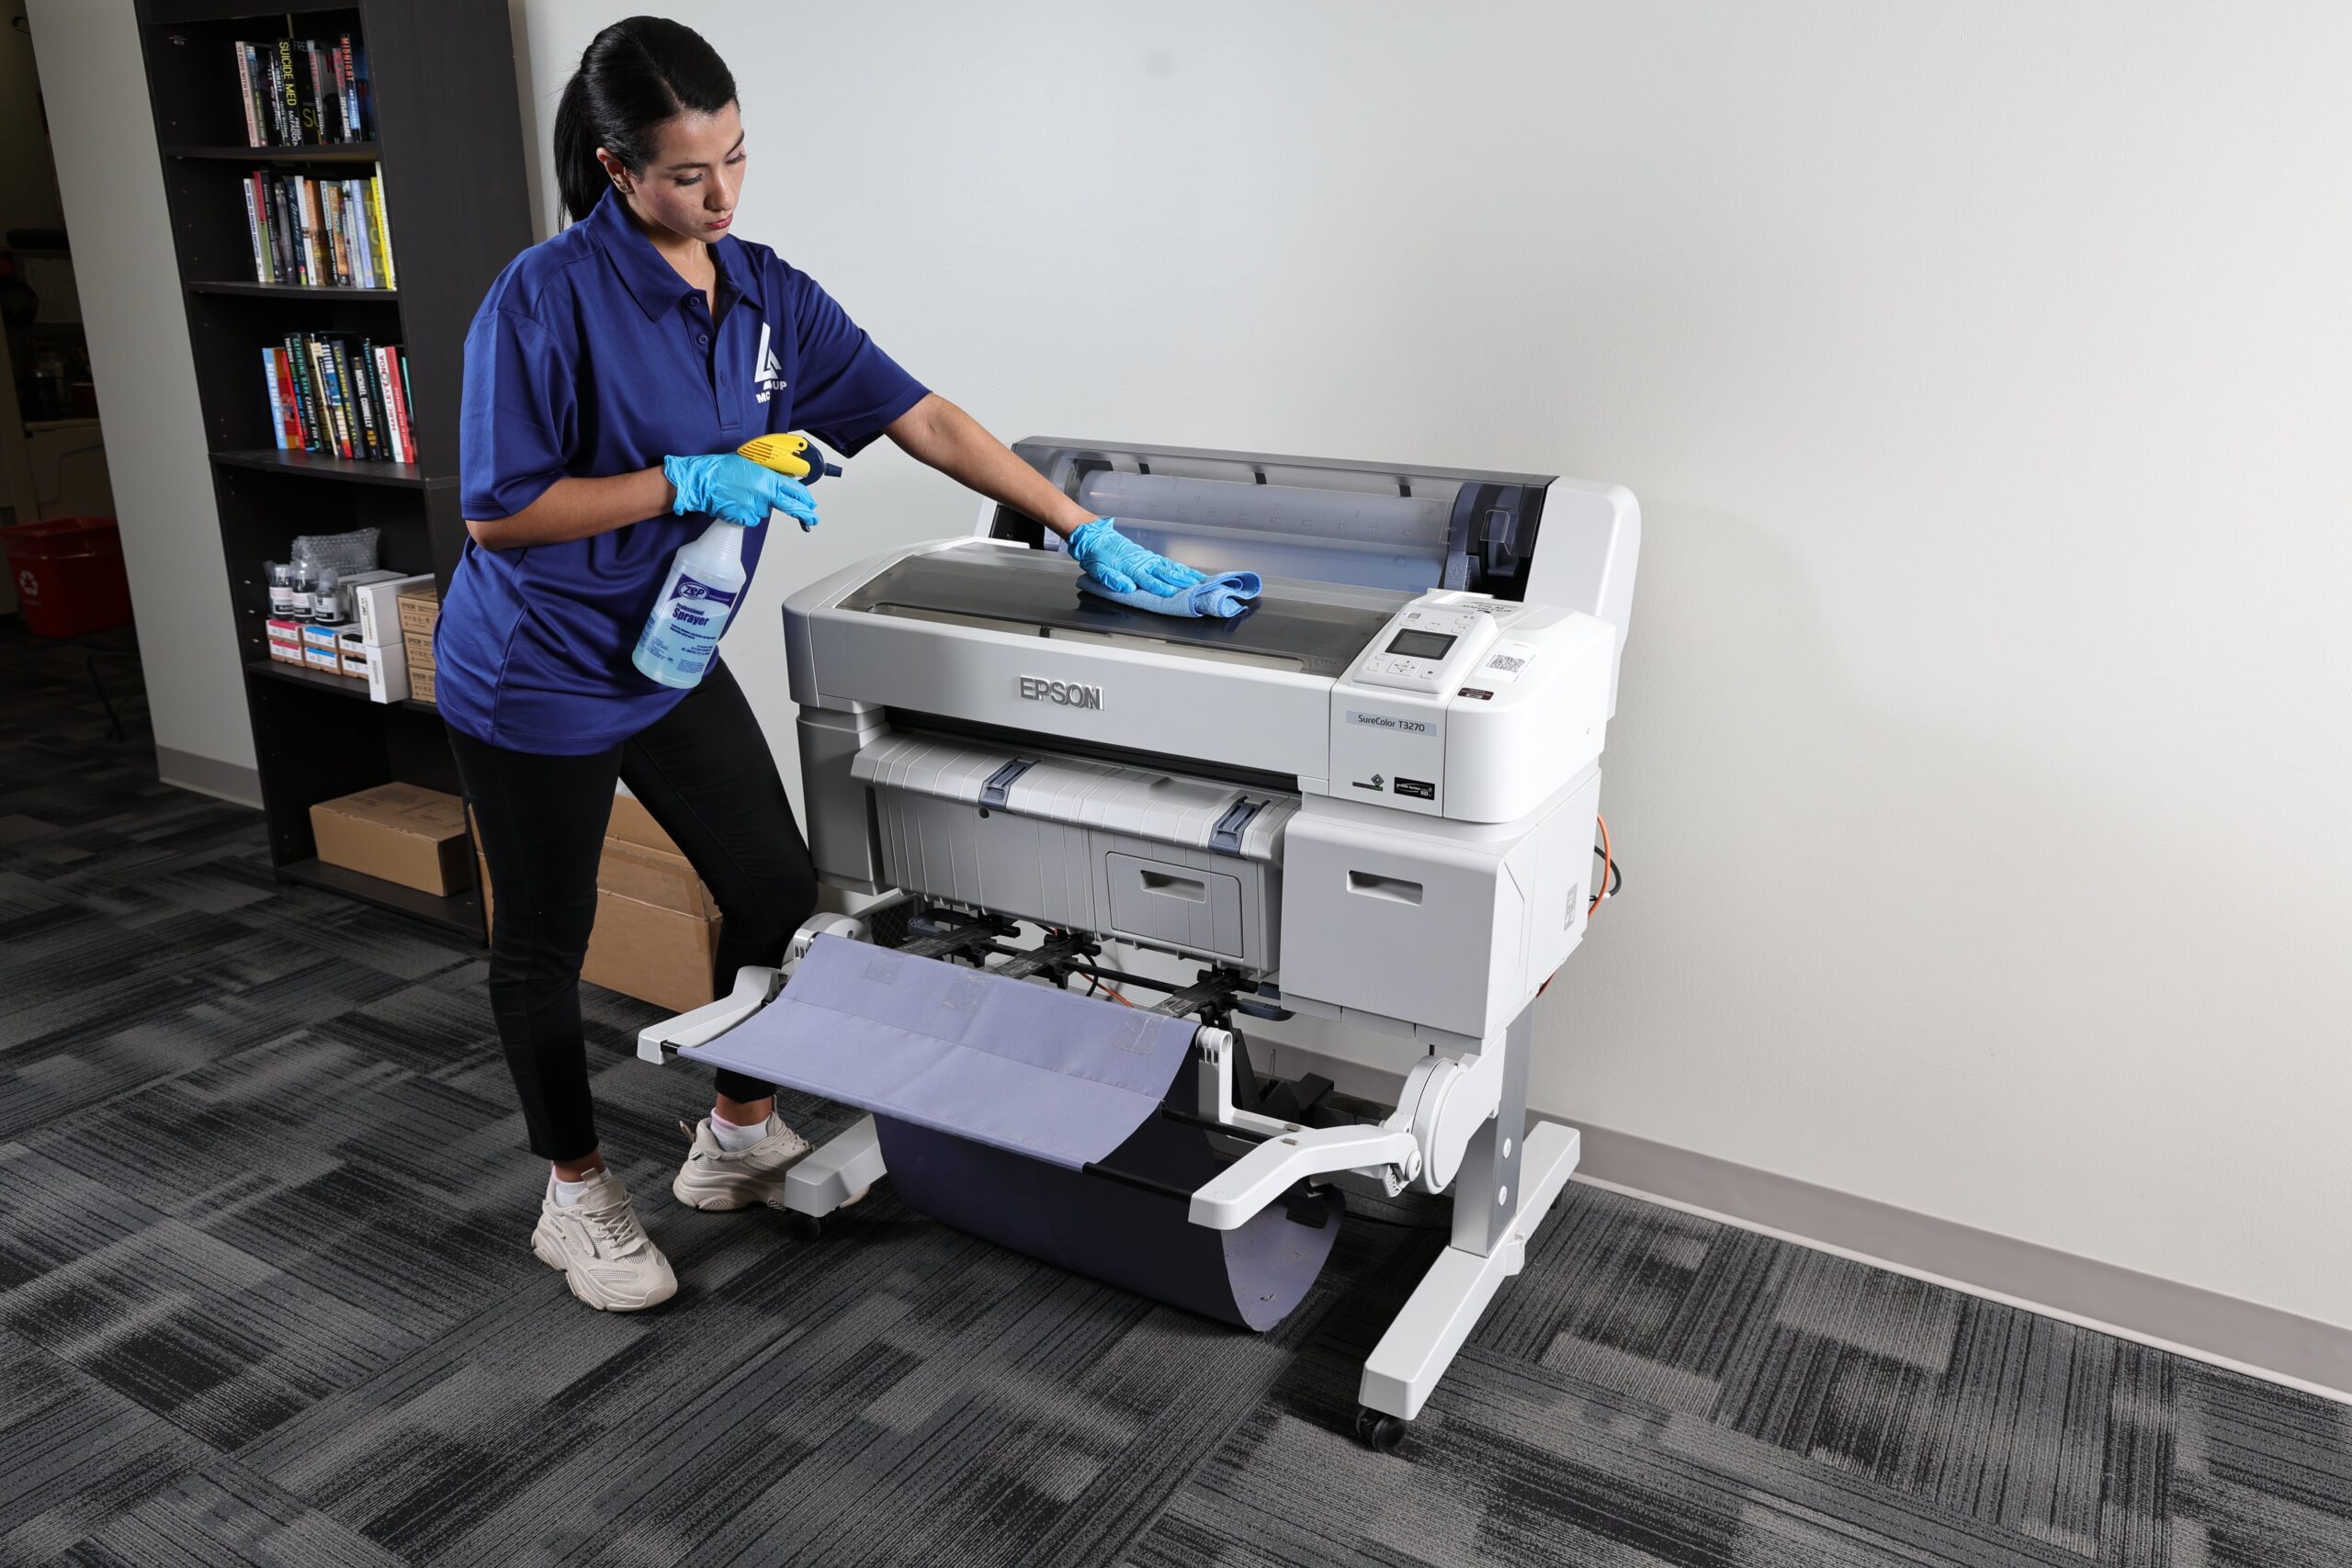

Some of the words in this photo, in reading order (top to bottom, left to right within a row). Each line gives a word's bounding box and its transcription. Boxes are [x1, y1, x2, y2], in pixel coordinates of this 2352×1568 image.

[279, 41, 293, 80] SUICIDE
[340, 34, 354, 81] MIDNIGHT
[285, 83, 297, 106] MED
[290, 203, 301, 241] ORCHARD
[285, 338, 294, 363] THEROUX
[293, 337, 306, 375] GATHERING
[337, 365, 348, 398] GARDNER
[355, 369, 367, 396] MICHAEL
[305, 396, 316, 425] CANDICE
[345, 402, 354, 425] NEVER
[360, 397, 373, 428] CONNELLY
[387, 406, 397, 431] MARC
[672, 608, 709, 626] Sprayer
[676, 602, 705, 615] Professional
[1020, 675, 1104, 711] EPSON
[1358, 714, 1396, 727] SureColor
[1399, 721, 1425, 732] T3270
